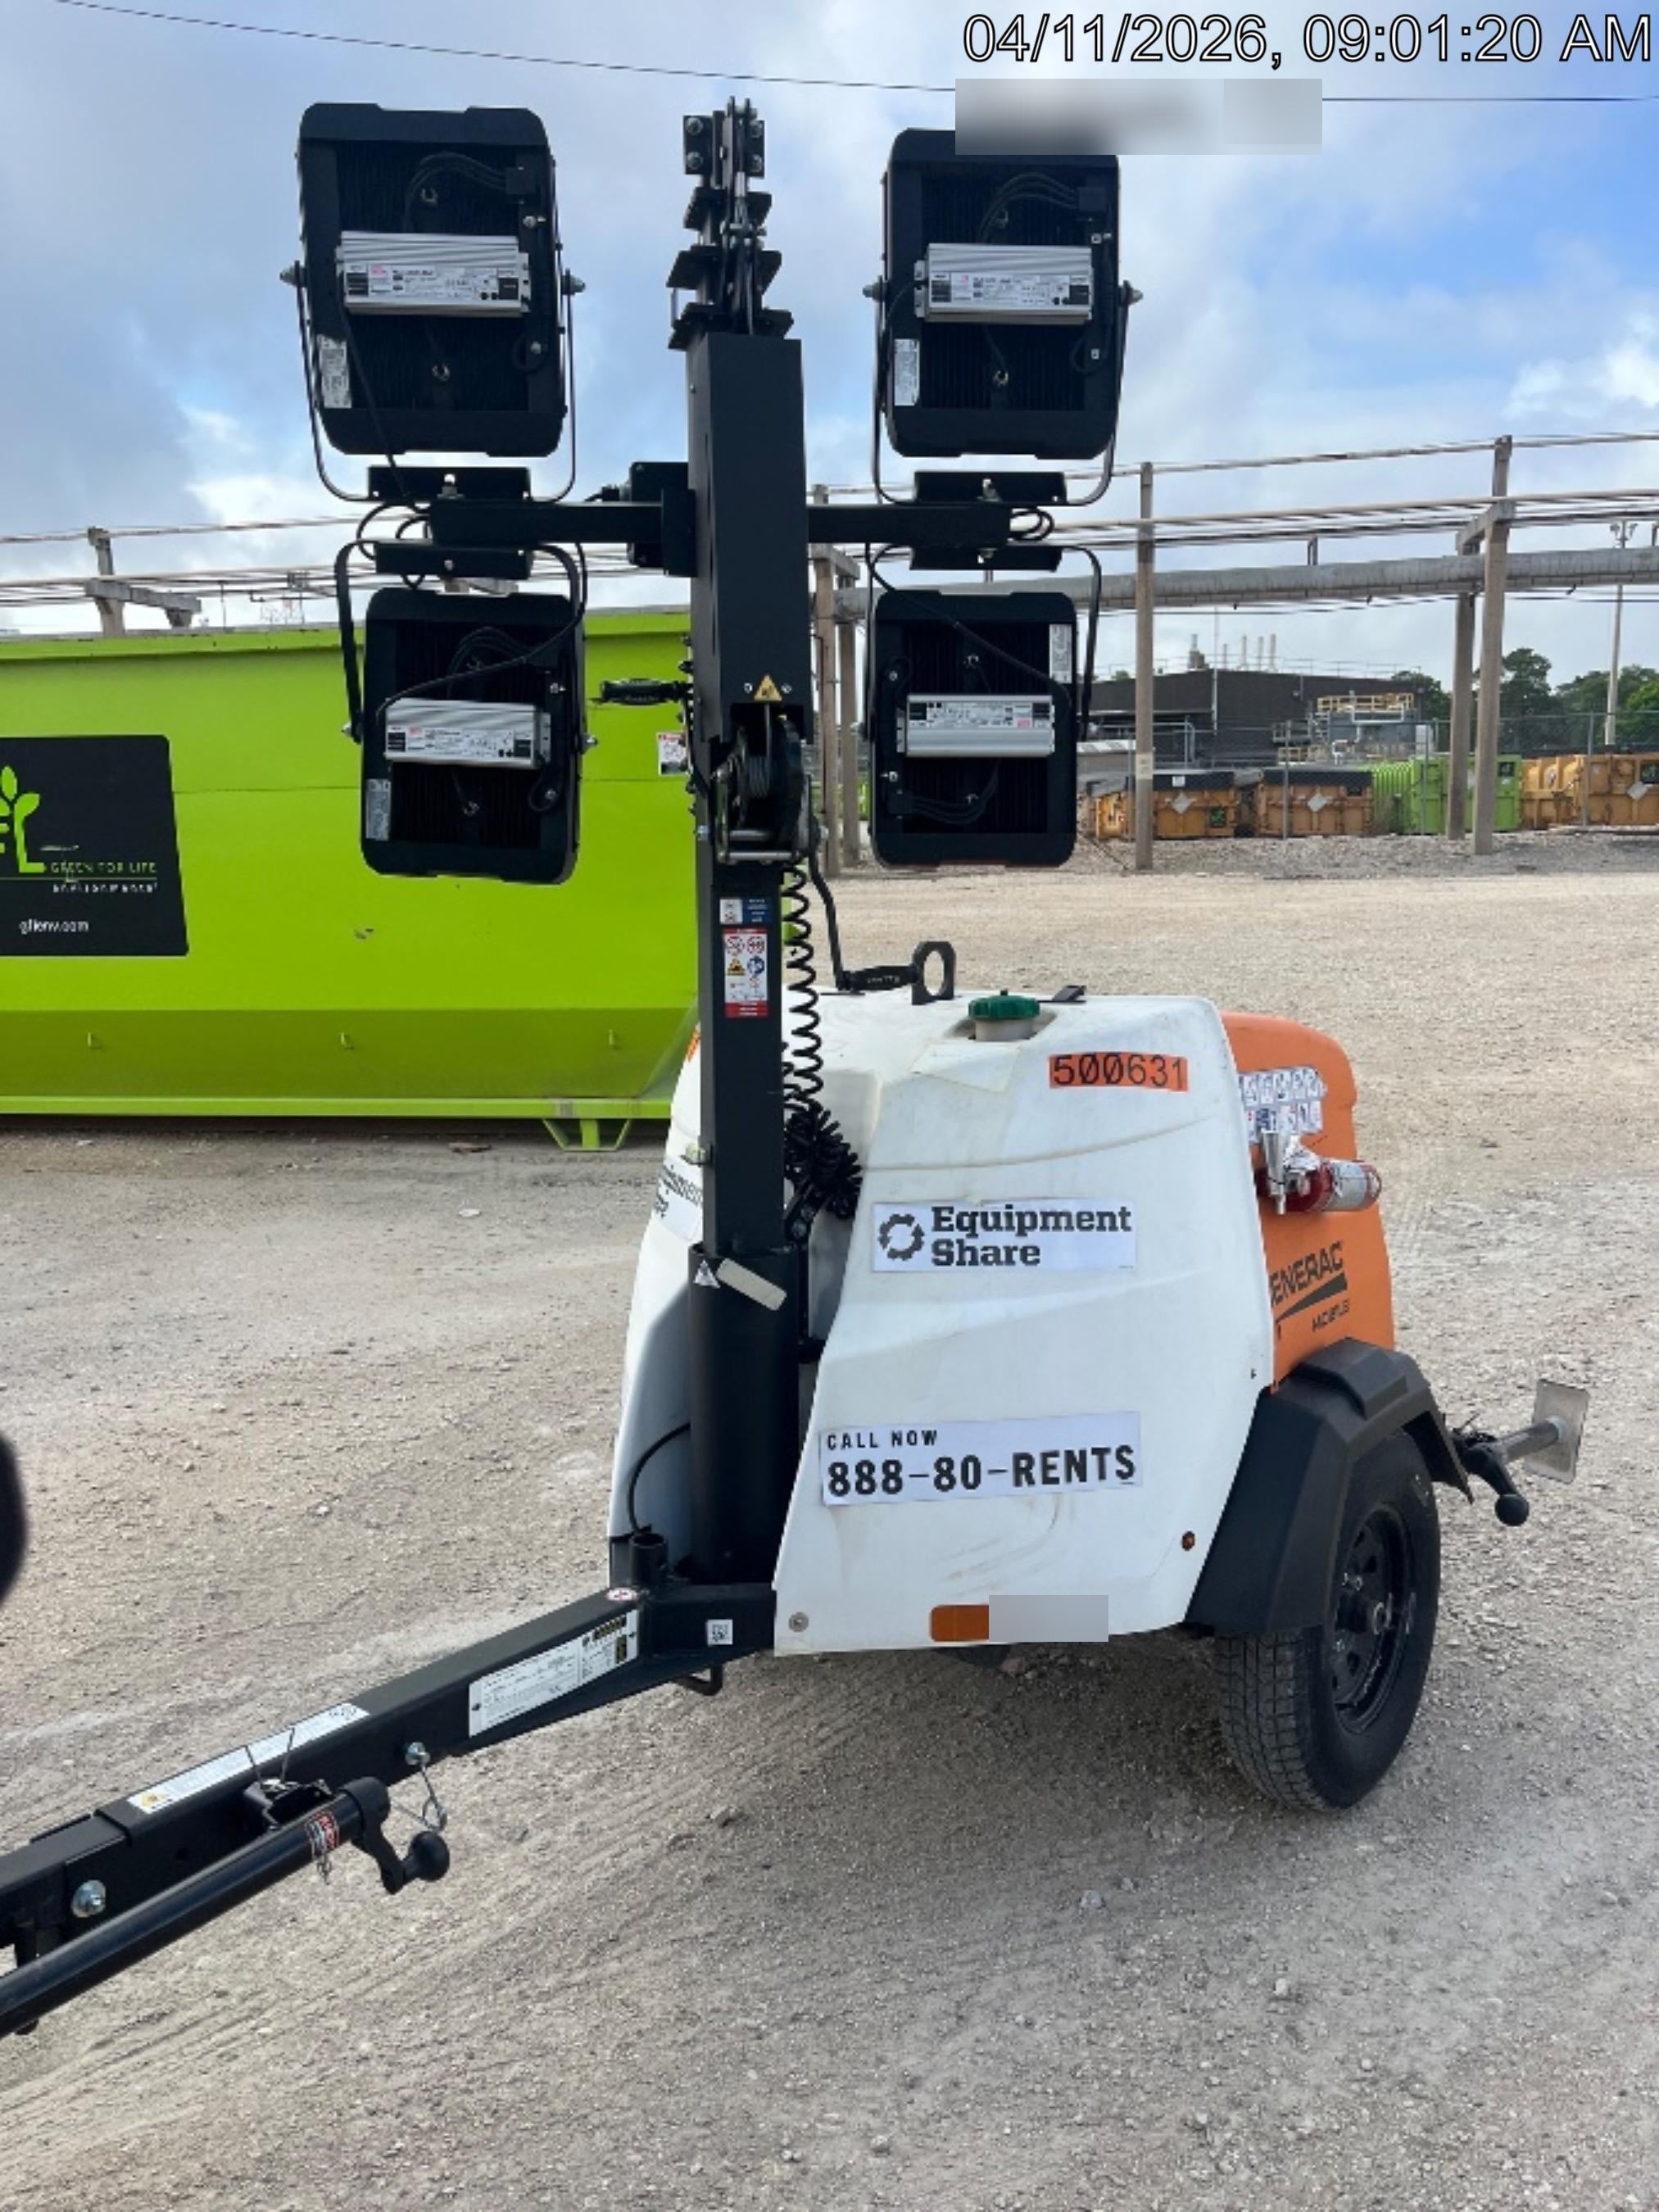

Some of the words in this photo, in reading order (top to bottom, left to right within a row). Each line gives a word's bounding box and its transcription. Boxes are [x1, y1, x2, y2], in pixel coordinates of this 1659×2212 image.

[129, 862, 156, 873] LIFE
[1054, 1053, 1184, 1090] 500631
[931, 1204, 1132, 1238] Equipment
[931, 1238, 1041, 1267] Share
[1270, 1240, 1344, 1308] ENERAC
[827, 1431, 880, 1451] CALL
[891, 1430, 938, 1448] NOW
[827, 1444, 1136, 1497] 888-80-RENTS
